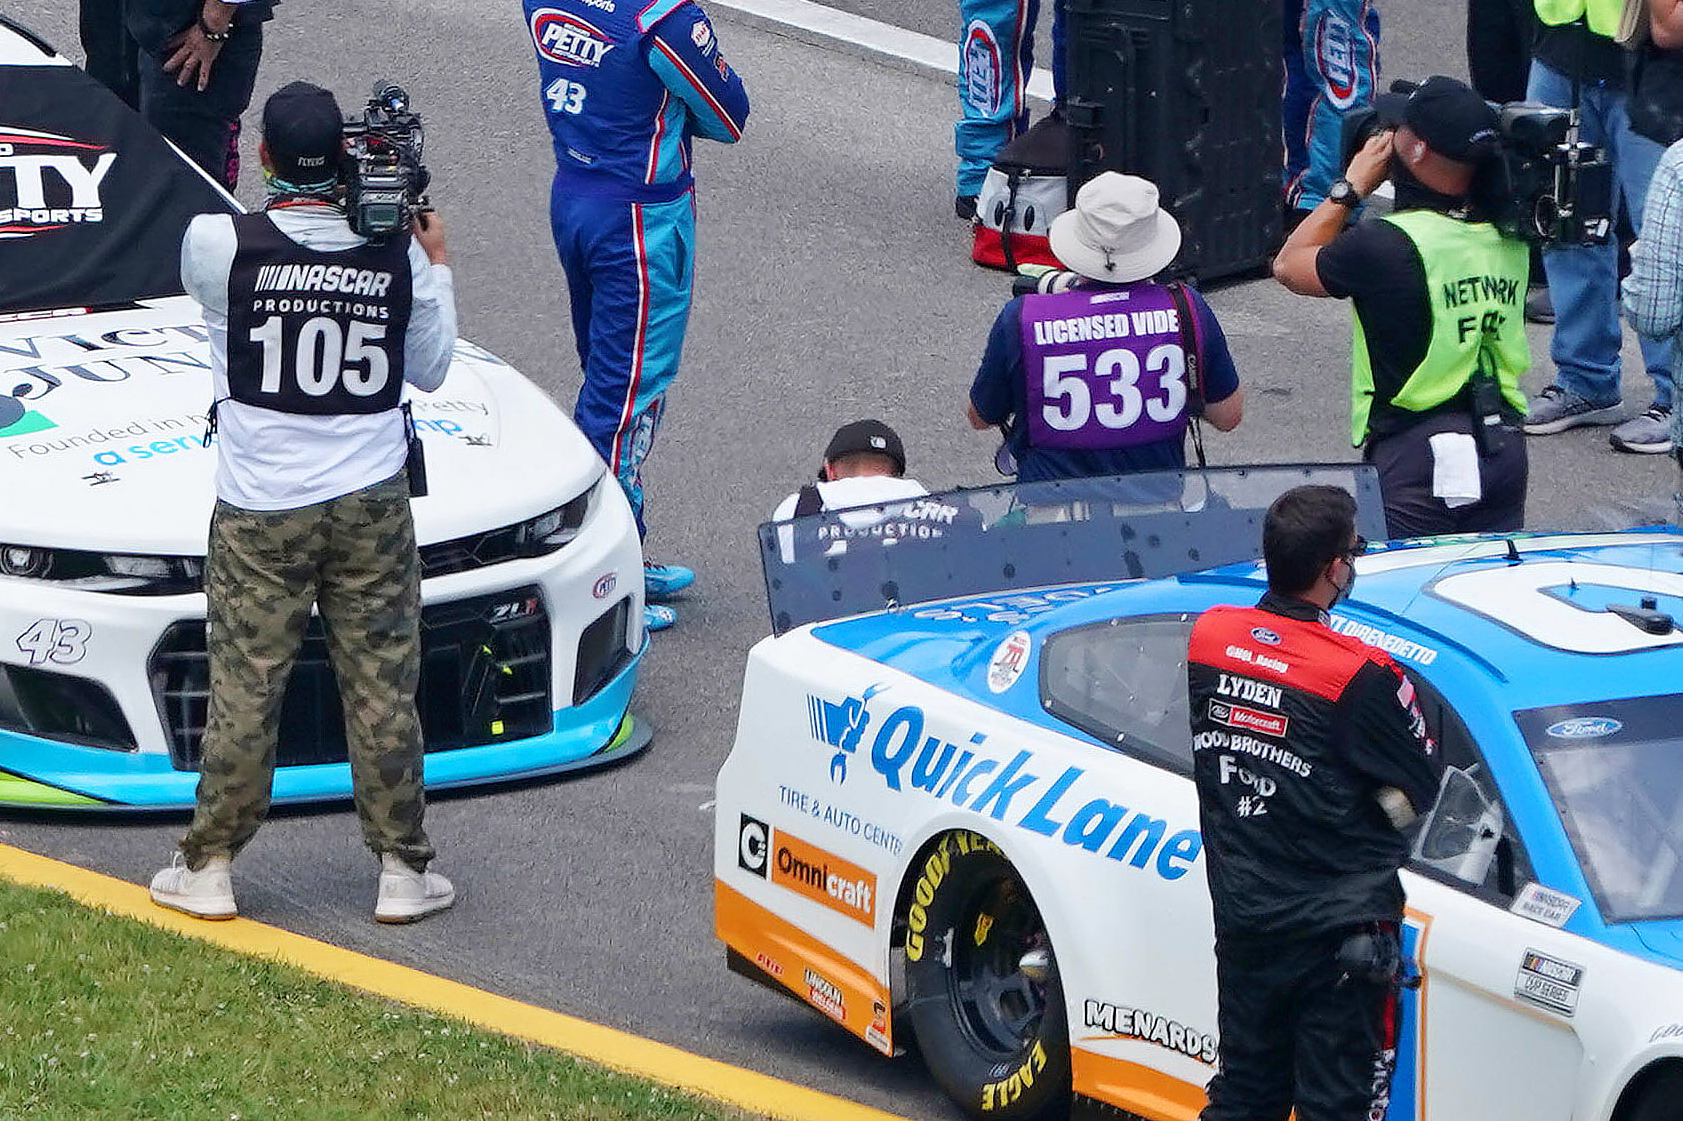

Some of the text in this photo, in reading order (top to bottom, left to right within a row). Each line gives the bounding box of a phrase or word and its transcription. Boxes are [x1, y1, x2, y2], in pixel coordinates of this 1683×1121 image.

[541, 22, 616, 64] PETTY
[546, 78, 587, 115] 43
[268, 265, 392, 296] NASCAR
[253, 298, 390, 320] PRODUCTIONS
[1034, 314, 1130, 345] LICENSED
[249, 316, 390, 398] 105
[1042, 344, 1187, 431] 533
[7, 421, 148, 461] Founded
[148, 419, 185, 431] in
[93, 450, 128, 466] a
[14, 617, 93, 666] 43
[1216, 673, 1284, 710] LYDEN
[1233, 711, 1282, 731] Motorcraft
[1563, 720, 1610, 738] Ford
[1229, 733, 1313, 778] BROTHERS
[779, 784, 809, 814] TIRE
[811, 799, 821, 818] &
[823, 805, 861, 836] AUTO
[871, 704, 1204, 882] Quick Lane
[777, 846, 872, 914] Omnicraft
[1084, 999, 1218, 1065] MENARDS
[981, 1039, 1047, 1112] EAGLE
